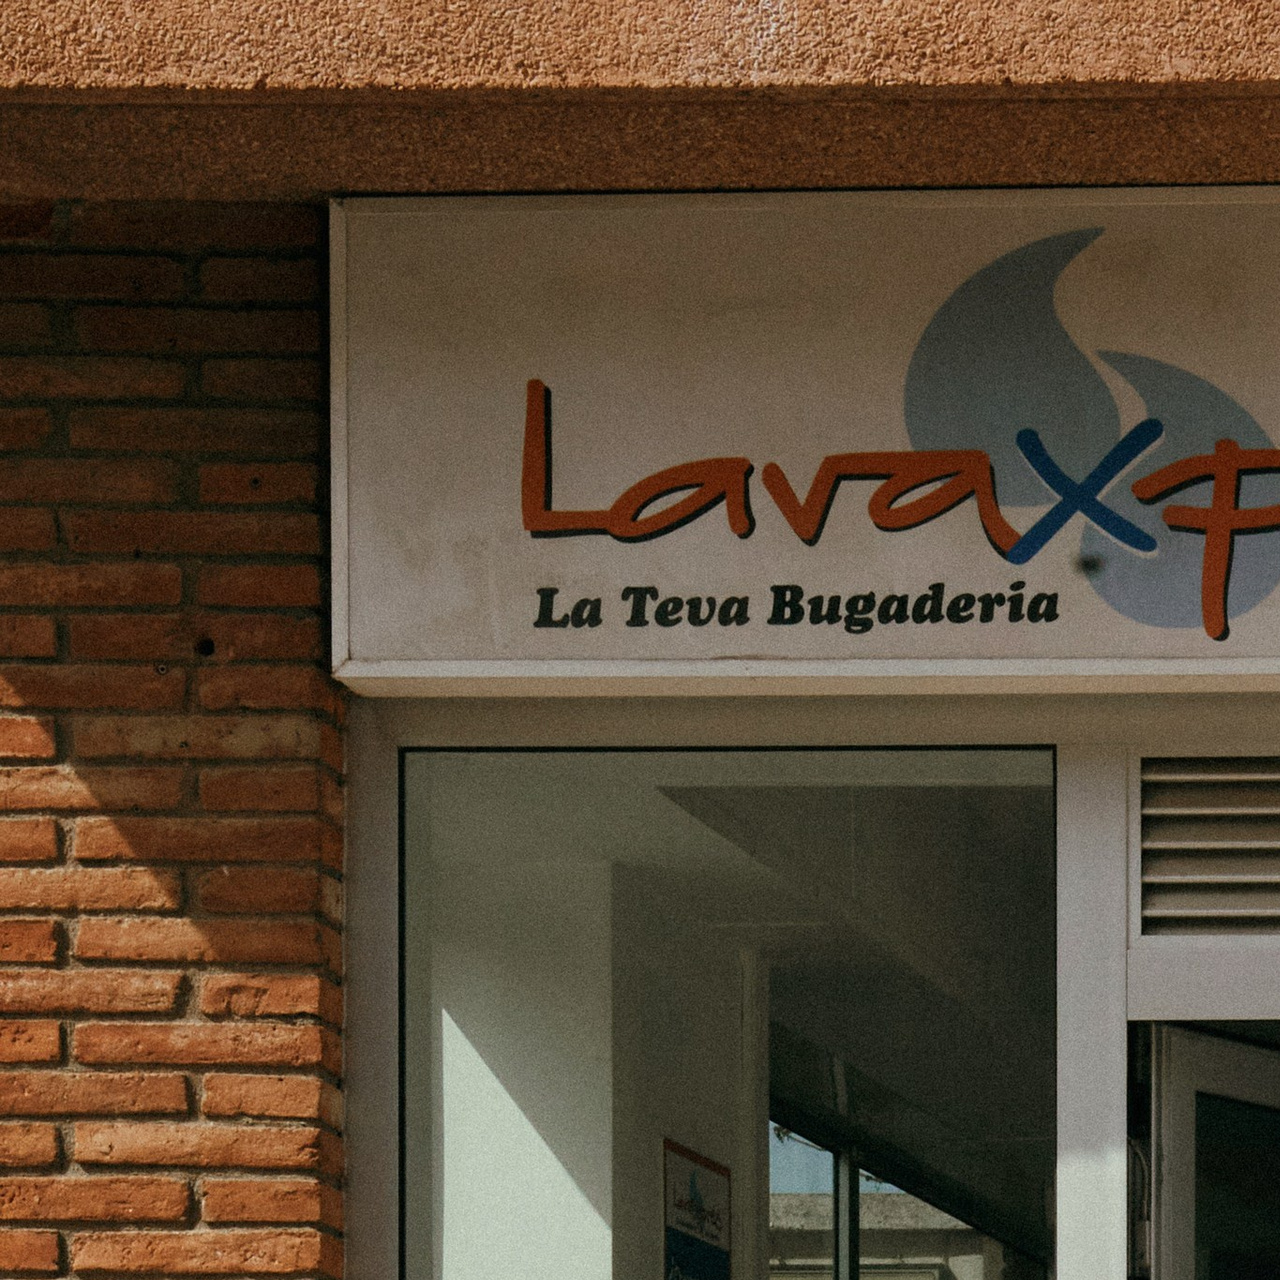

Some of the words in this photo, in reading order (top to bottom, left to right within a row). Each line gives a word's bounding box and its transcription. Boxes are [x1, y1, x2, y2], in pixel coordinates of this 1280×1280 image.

[533, 587, 602, 628] La
[621, 586, 750, 627] Teva
[766, 580, 1059, 635] Bugaderia
